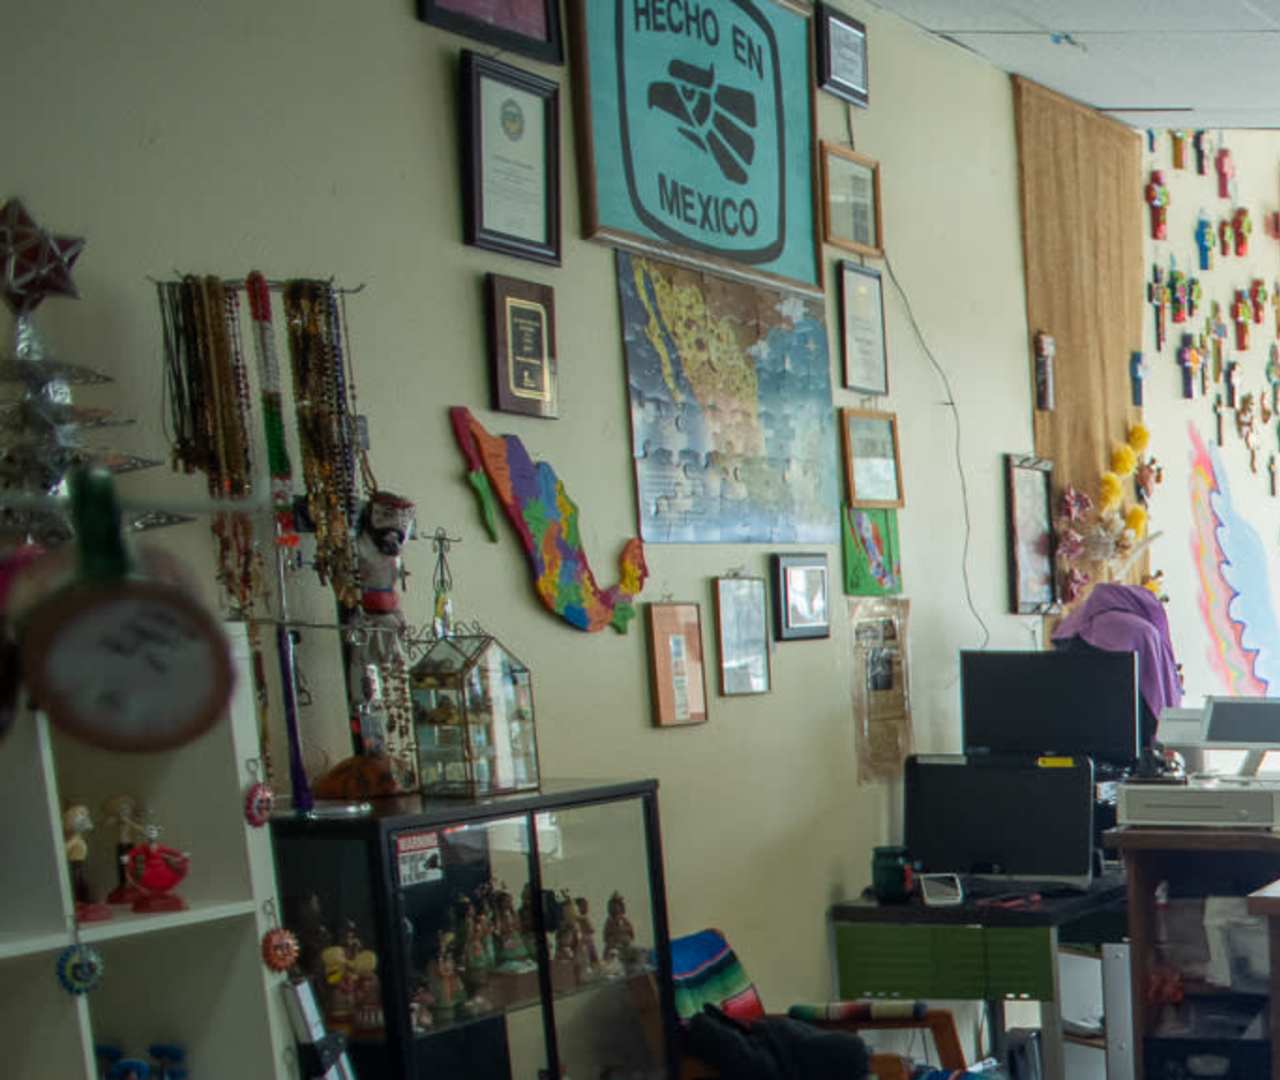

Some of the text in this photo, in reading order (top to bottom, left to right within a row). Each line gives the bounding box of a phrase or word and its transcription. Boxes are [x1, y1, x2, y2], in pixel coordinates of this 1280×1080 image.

[634, 0, 764, 80] HECHO EN
[658, 172, 758, 237] MEXICO
